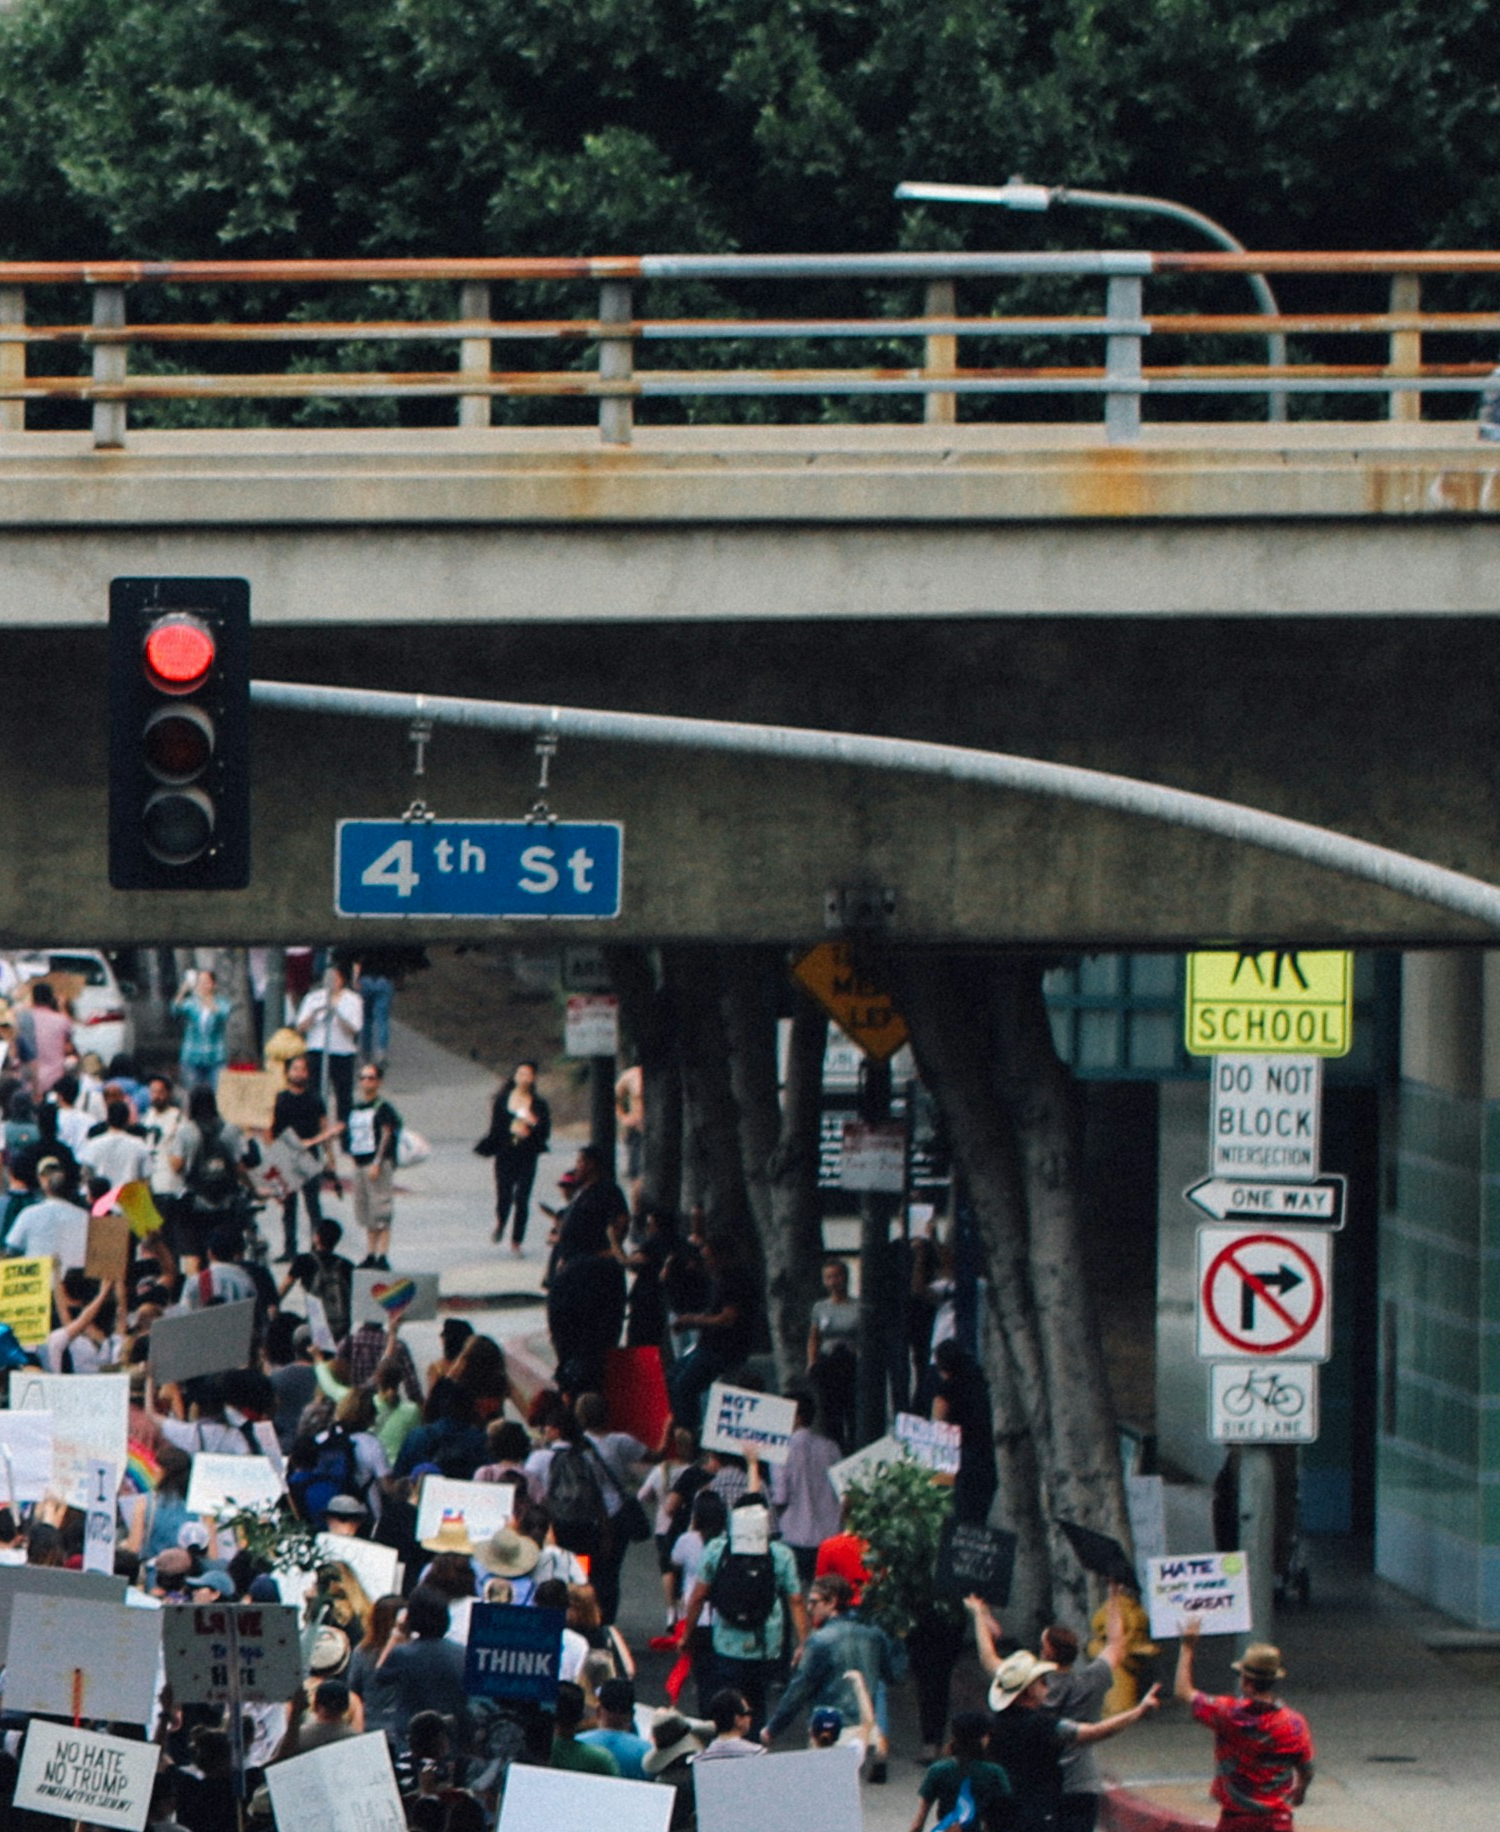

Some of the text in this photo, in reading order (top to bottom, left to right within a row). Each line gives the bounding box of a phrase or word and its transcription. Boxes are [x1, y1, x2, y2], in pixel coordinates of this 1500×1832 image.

[361, 838, 595, 897] 4th St
[1198, 1008, 1338, 1044] SCHOOL
[1219, 1066, 1312, 1094] DO NOT
[1218, 1107, 1312, 1136] BLOCK
[1218, 1145, 1312, 1167] INTERSECTION
[1231, 1189, 1325, 1211] ONE WAY
[722, 1394, 759, 1411] NOT
[718, 1410, 743, 1425] MY
[1223, 1419, 1300, 1436] BIKE LANE
[476, 1647, 552, 1675] THINK
[56, 1741, 125, 1769] NO HATE
[44, 1760, 128, 1793] NO TRUMP
